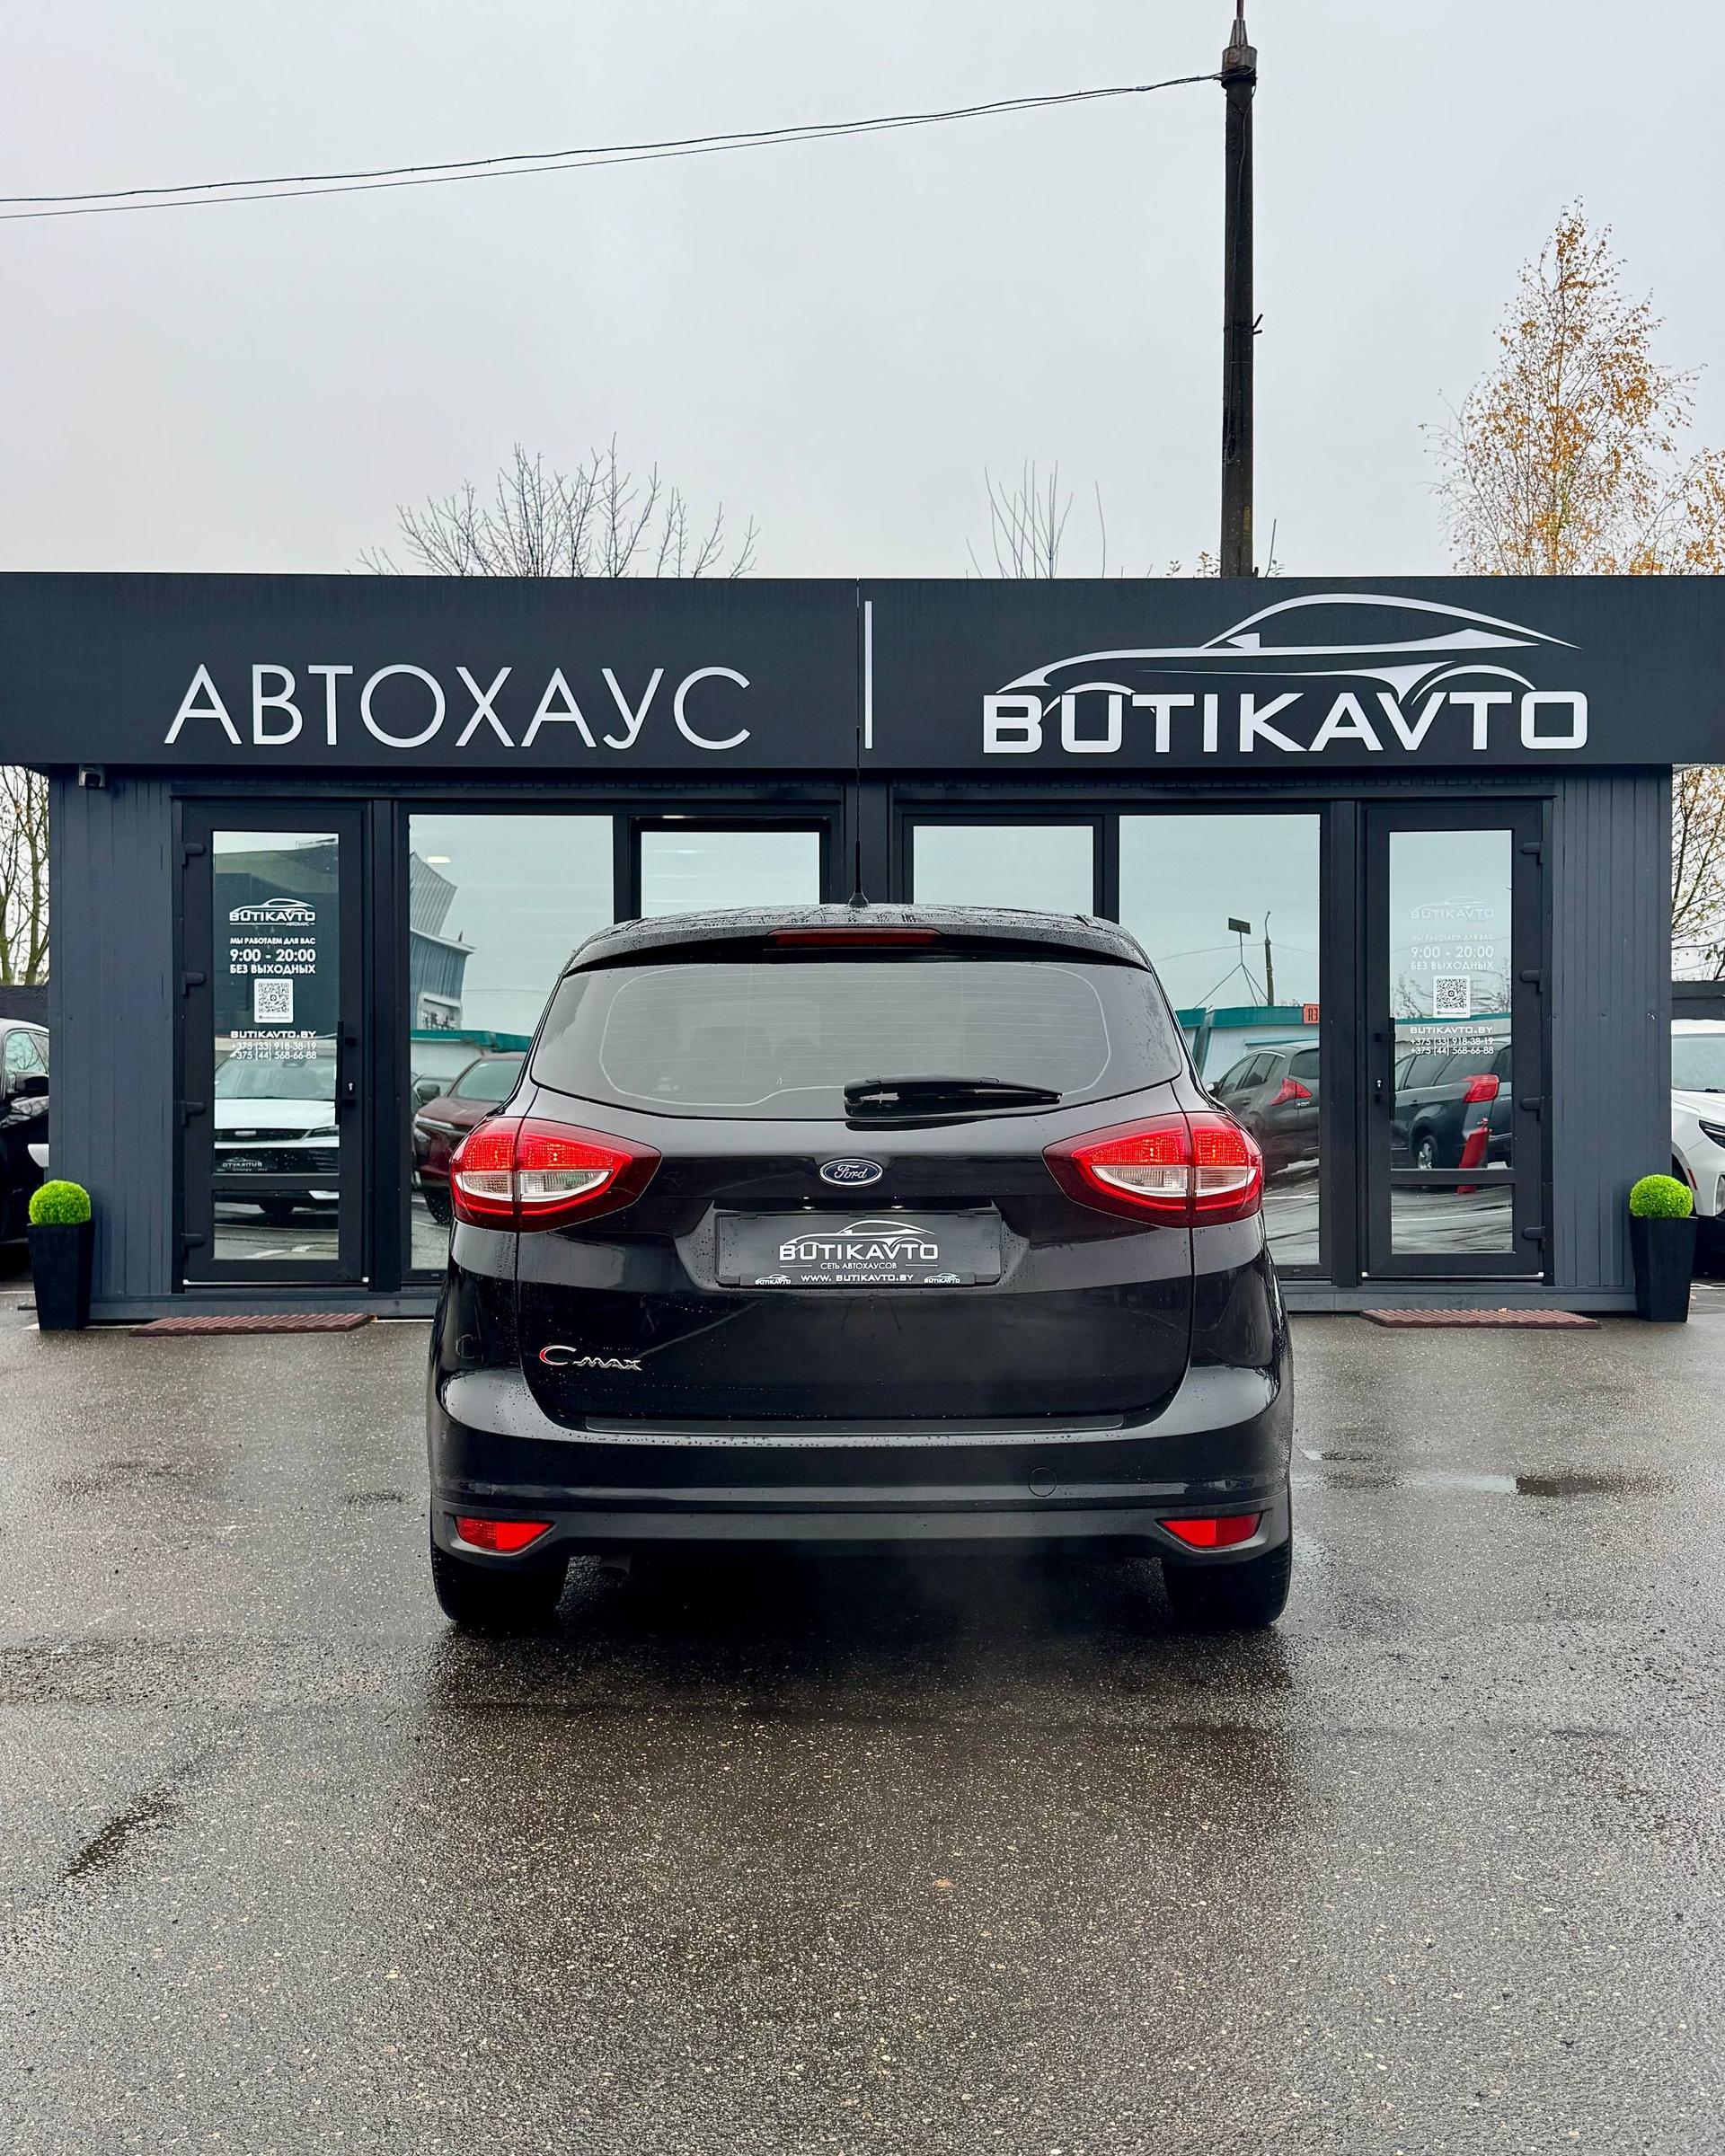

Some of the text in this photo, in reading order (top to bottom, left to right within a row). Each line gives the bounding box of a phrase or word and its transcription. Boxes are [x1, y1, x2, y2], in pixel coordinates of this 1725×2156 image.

[164, 663, 751, 750] АВТОХАУС
[983, 690, 1588, 754] BUTIKAVTO
[229, 911, 315, 922] BUTIKAVTO
[1410, 908, 1494, 920] BUTIKAVTO
[230, 950, 261, 962] 9:00
[276, 950, 316, 962] 20:00
[1411, 946, 1440, 959] 9:00
[1455, 946, 1494, 959] 20:00
[230, 965, 316, 975] БЕЗ ВЫХОДНЫХ
[1411, 961, 1494, 971] БЕЗ ВЫХОДНЫХ
[255, 1042, 271, 1052] (33)
[1411, 1037, 1494, 1047] +375 (33) 918-38-19
[255, 1051, 271, 1061] (44)
[274, 1051, 316, 1059] 568-66-88
[1411, 1046, 1494, 1056] +375 (44) 568-66-88
[834, 1164, 867, 1179] Ford
[779, 1243, 938, 1260] BUTIKAVTO
[836, 1274, 914, 1282] BUTIKAVTO.BY
